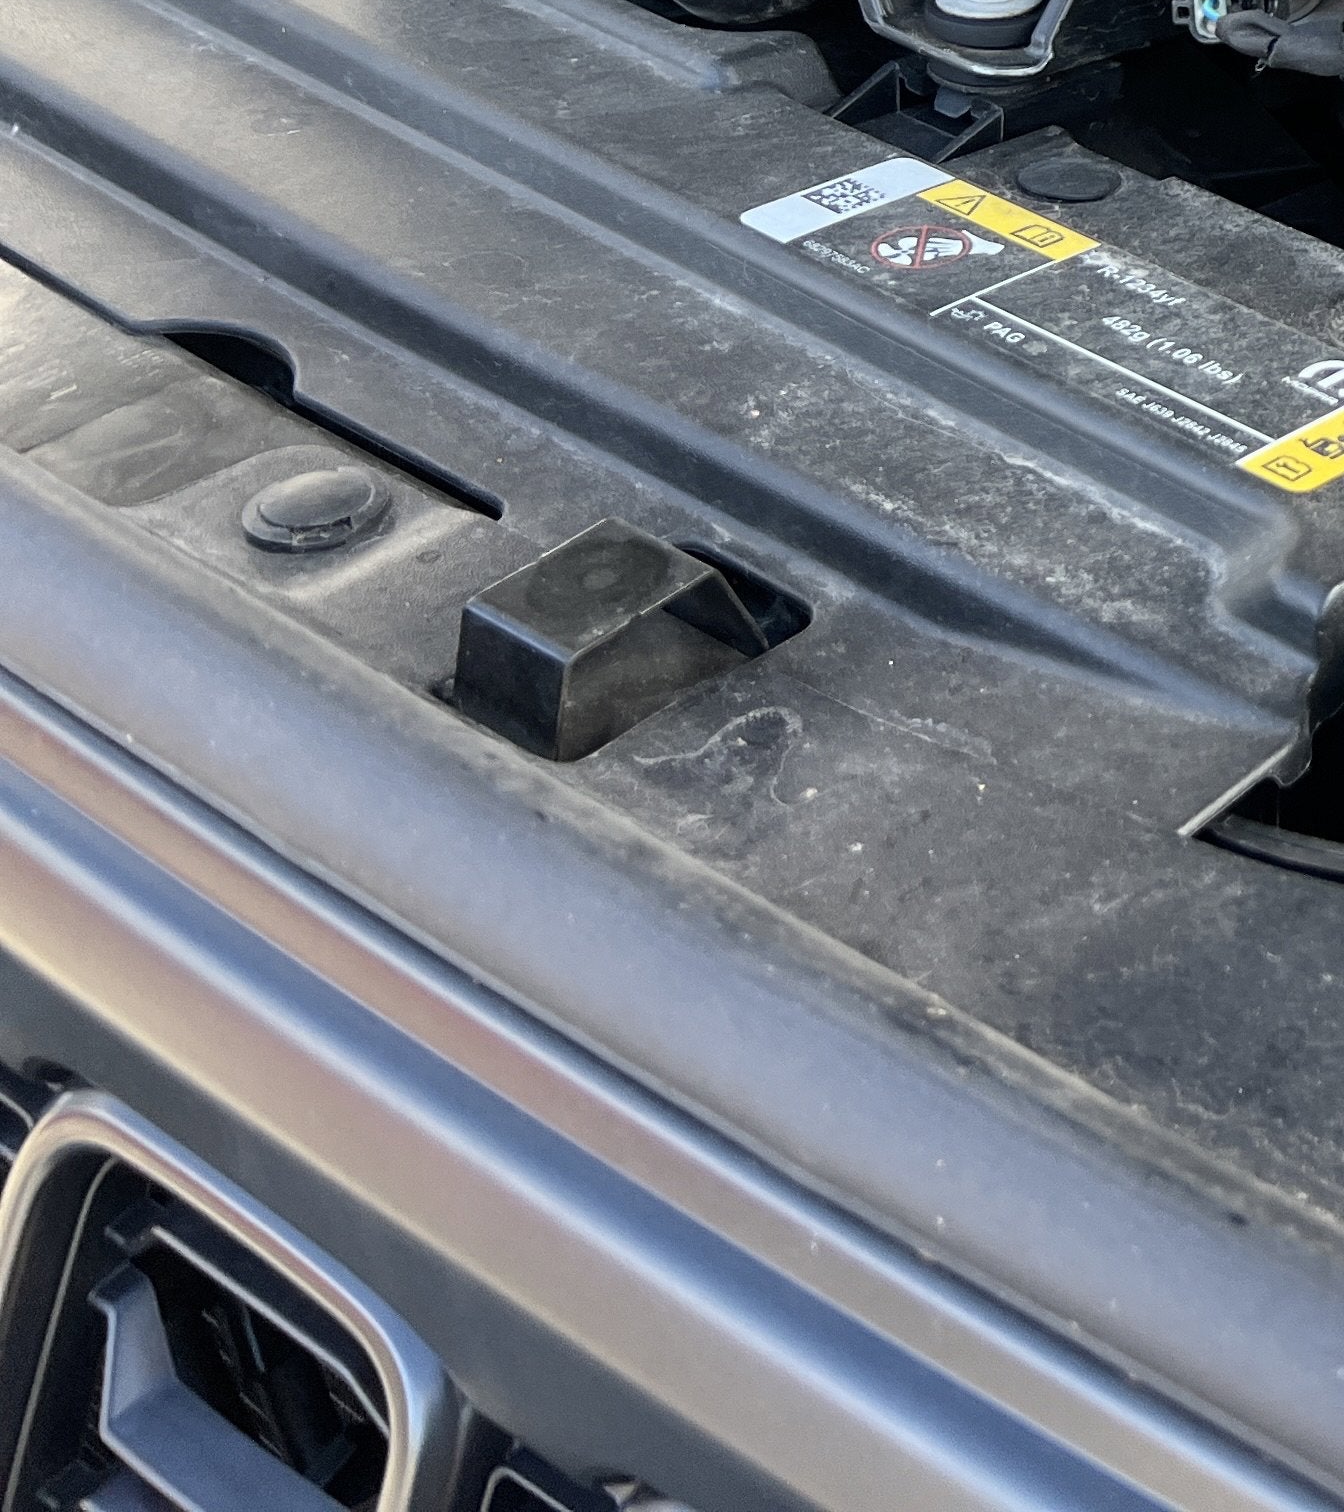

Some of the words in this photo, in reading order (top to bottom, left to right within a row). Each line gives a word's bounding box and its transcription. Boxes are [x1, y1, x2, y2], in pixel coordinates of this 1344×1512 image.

[1096, 264, 1186, 307] R-1234yf
[983, 321, 1026, 344] PAG
[1101, 315, 1151, 343] 482g
[1146, 337, 1203, 365] (1.06
[1199, 359, 1244, 385] lbs)
[1115, 388, 1148, 405] SAE
